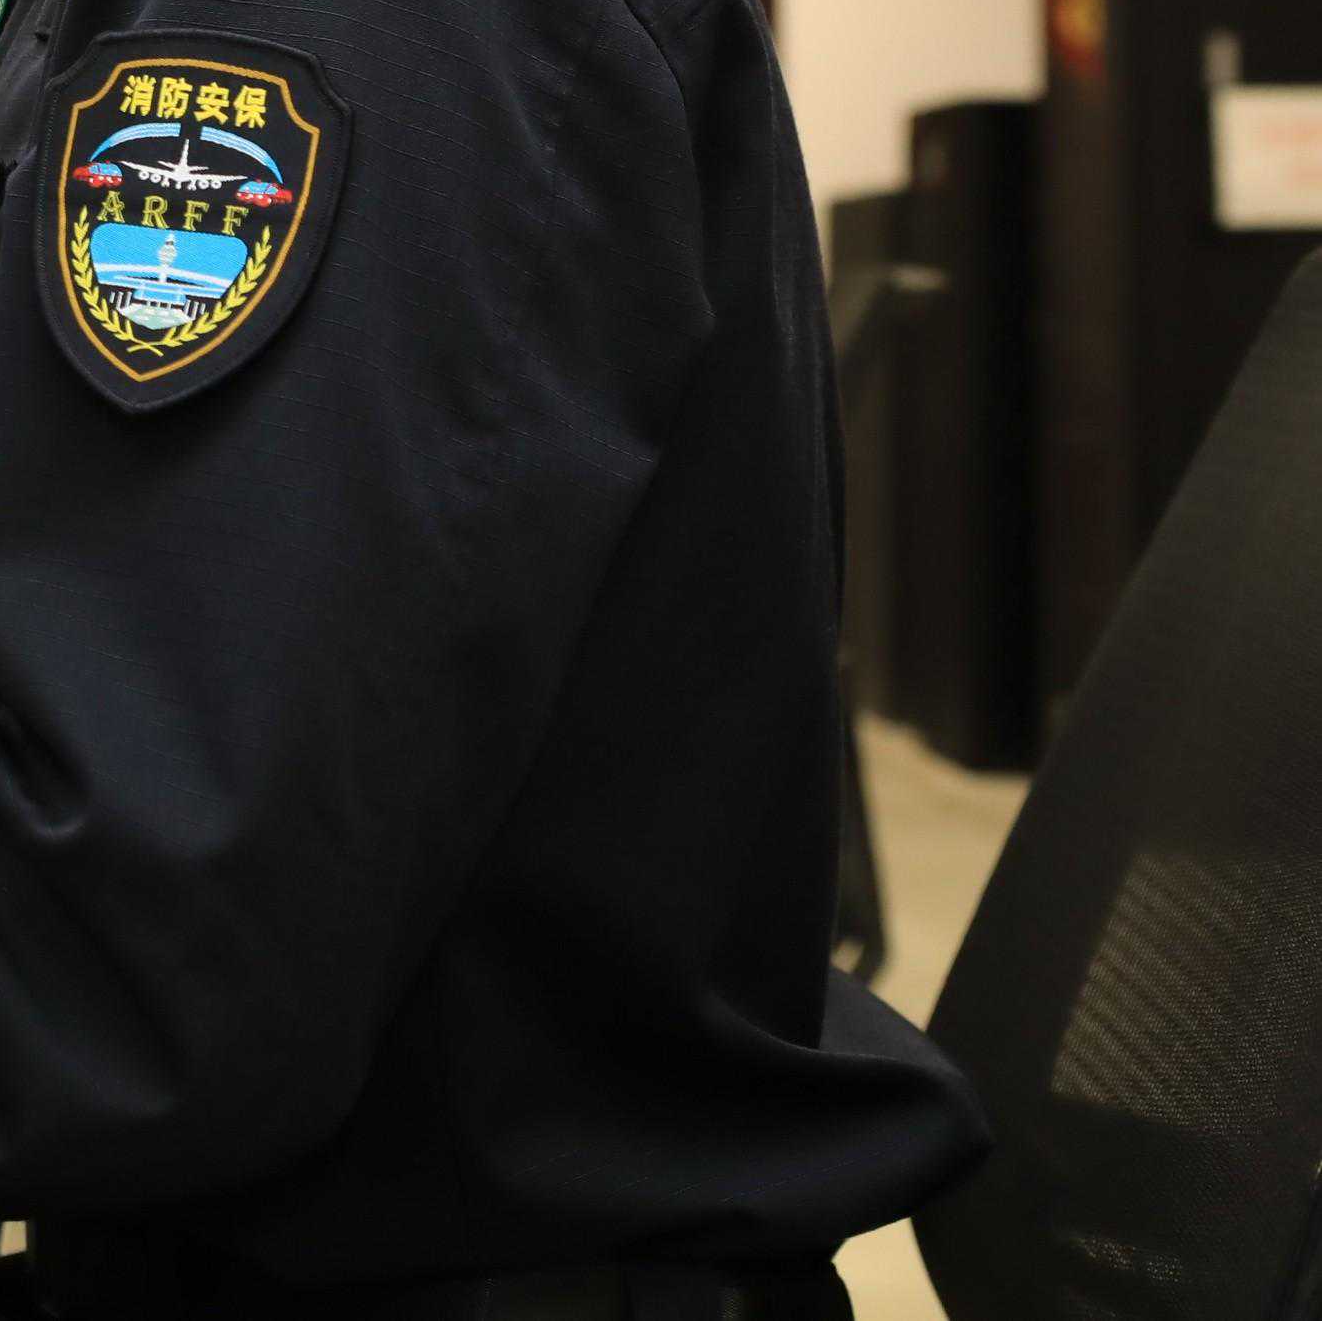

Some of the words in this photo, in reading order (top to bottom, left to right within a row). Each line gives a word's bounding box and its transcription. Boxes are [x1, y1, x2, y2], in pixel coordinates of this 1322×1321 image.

[119, 74, 269, 129] 消防安保
[96, 190, 250, 237] ARFF
